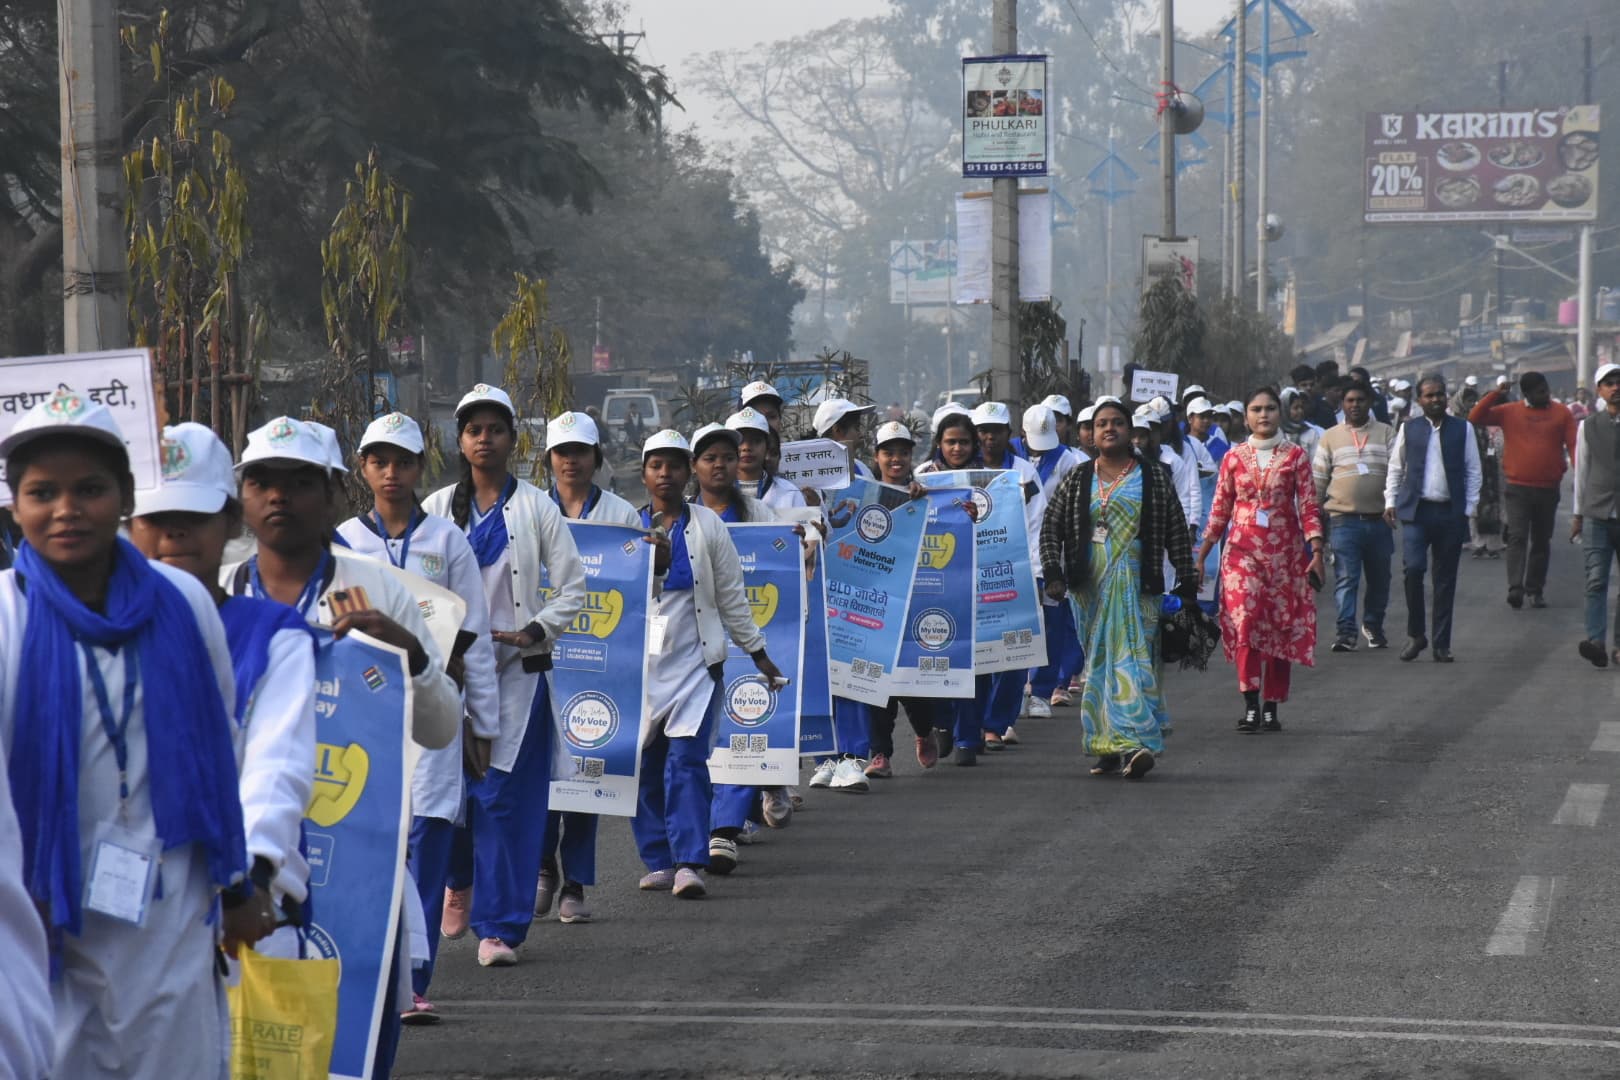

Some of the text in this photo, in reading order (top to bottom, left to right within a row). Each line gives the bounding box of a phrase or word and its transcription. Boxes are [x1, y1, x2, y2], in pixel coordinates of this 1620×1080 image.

[972, 120, 1037, 130] PHULKARI
[1382, 154, 1412, 163] FLAT
[1371, 164, 1422, 196] 20%
[784, 452, 800, 462] तेज
[802, 469, 814, 478] का
[818, 466, 844, 476] कारण
[976, 526, 1008, 538] ational
[922, 536, 940, 549] ALL
[976, 536, 1008, 546] ters' Day
[858, 547, 896, 565] National
[878, 563, 893, 574] Day
[829, 580, 852, 596] BLO
[734, 698, 767, 706] My Vote
[316, 702, 336, 718] ay
[571, 716, 608, 727] My Vote
[254, 1022, 300, 1042] RATE
